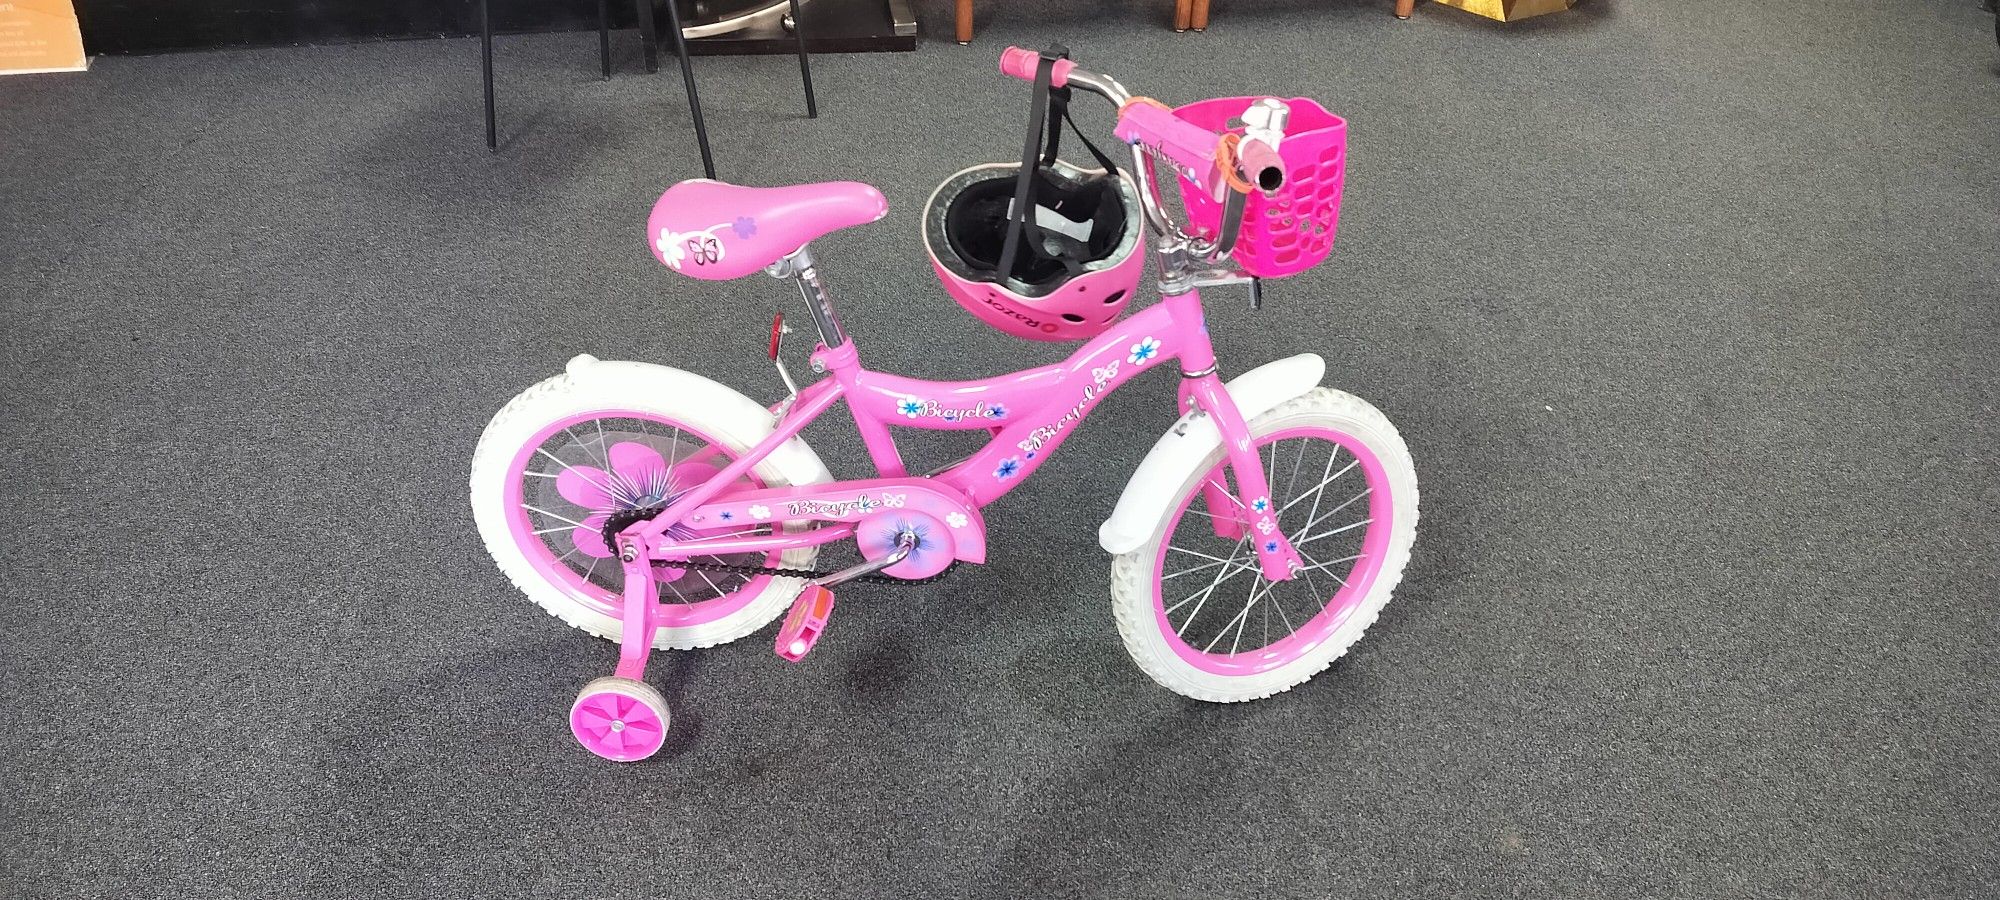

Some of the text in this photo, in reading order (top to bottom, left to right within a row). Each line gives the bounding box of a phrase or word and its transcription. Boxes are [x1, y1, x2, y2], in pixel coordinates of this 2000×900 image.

[919, 399, 995, 423] Bicycle
[1031, 380, 1108, 451] Bicycle
[787, 493, 882, 518] Bicycle
